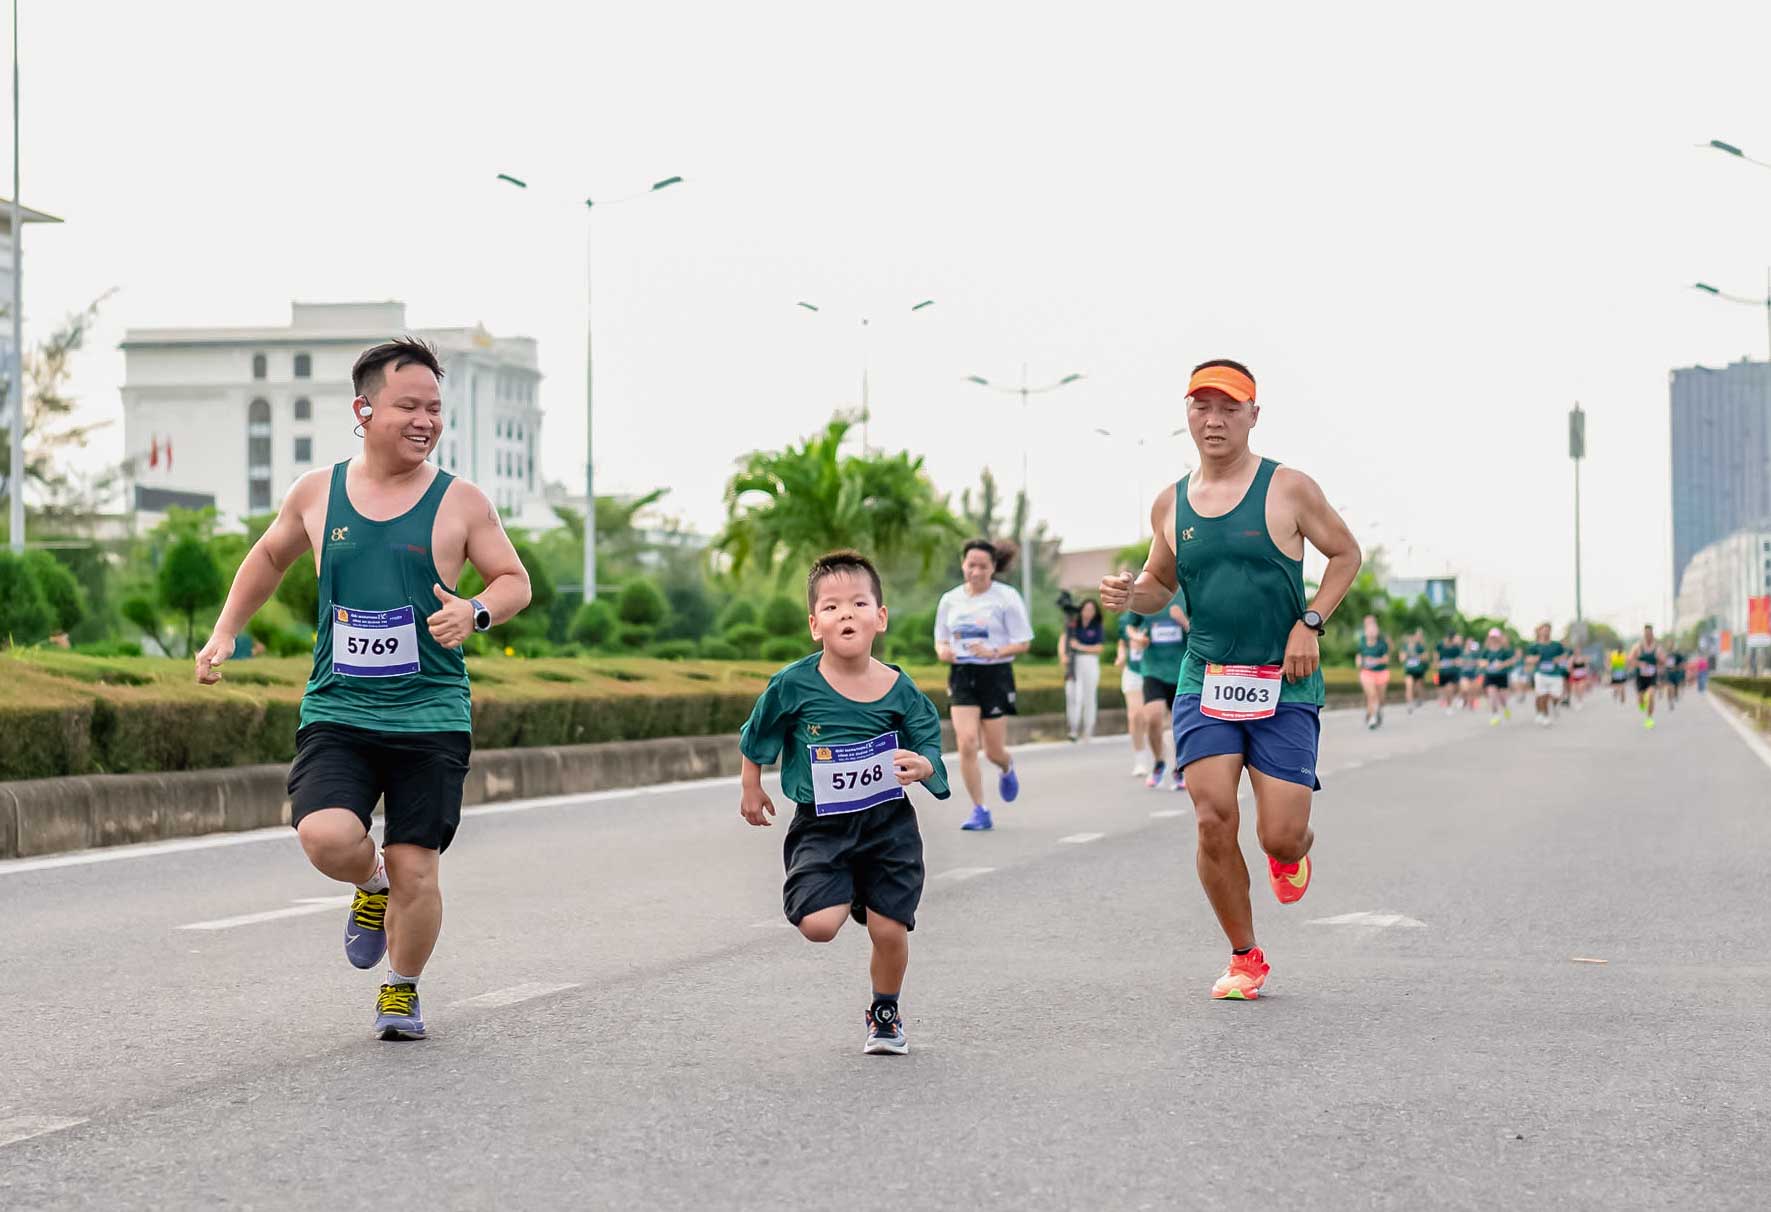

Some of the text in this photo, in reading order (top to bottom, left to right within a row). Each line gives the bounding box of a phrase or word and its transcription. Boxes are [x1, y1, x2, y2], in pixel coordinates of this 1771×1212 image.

[348, 636, 399, 655] 5769
[1214, 685, 1269, 703] 10063
[832, 764, 883, 790] 5768
